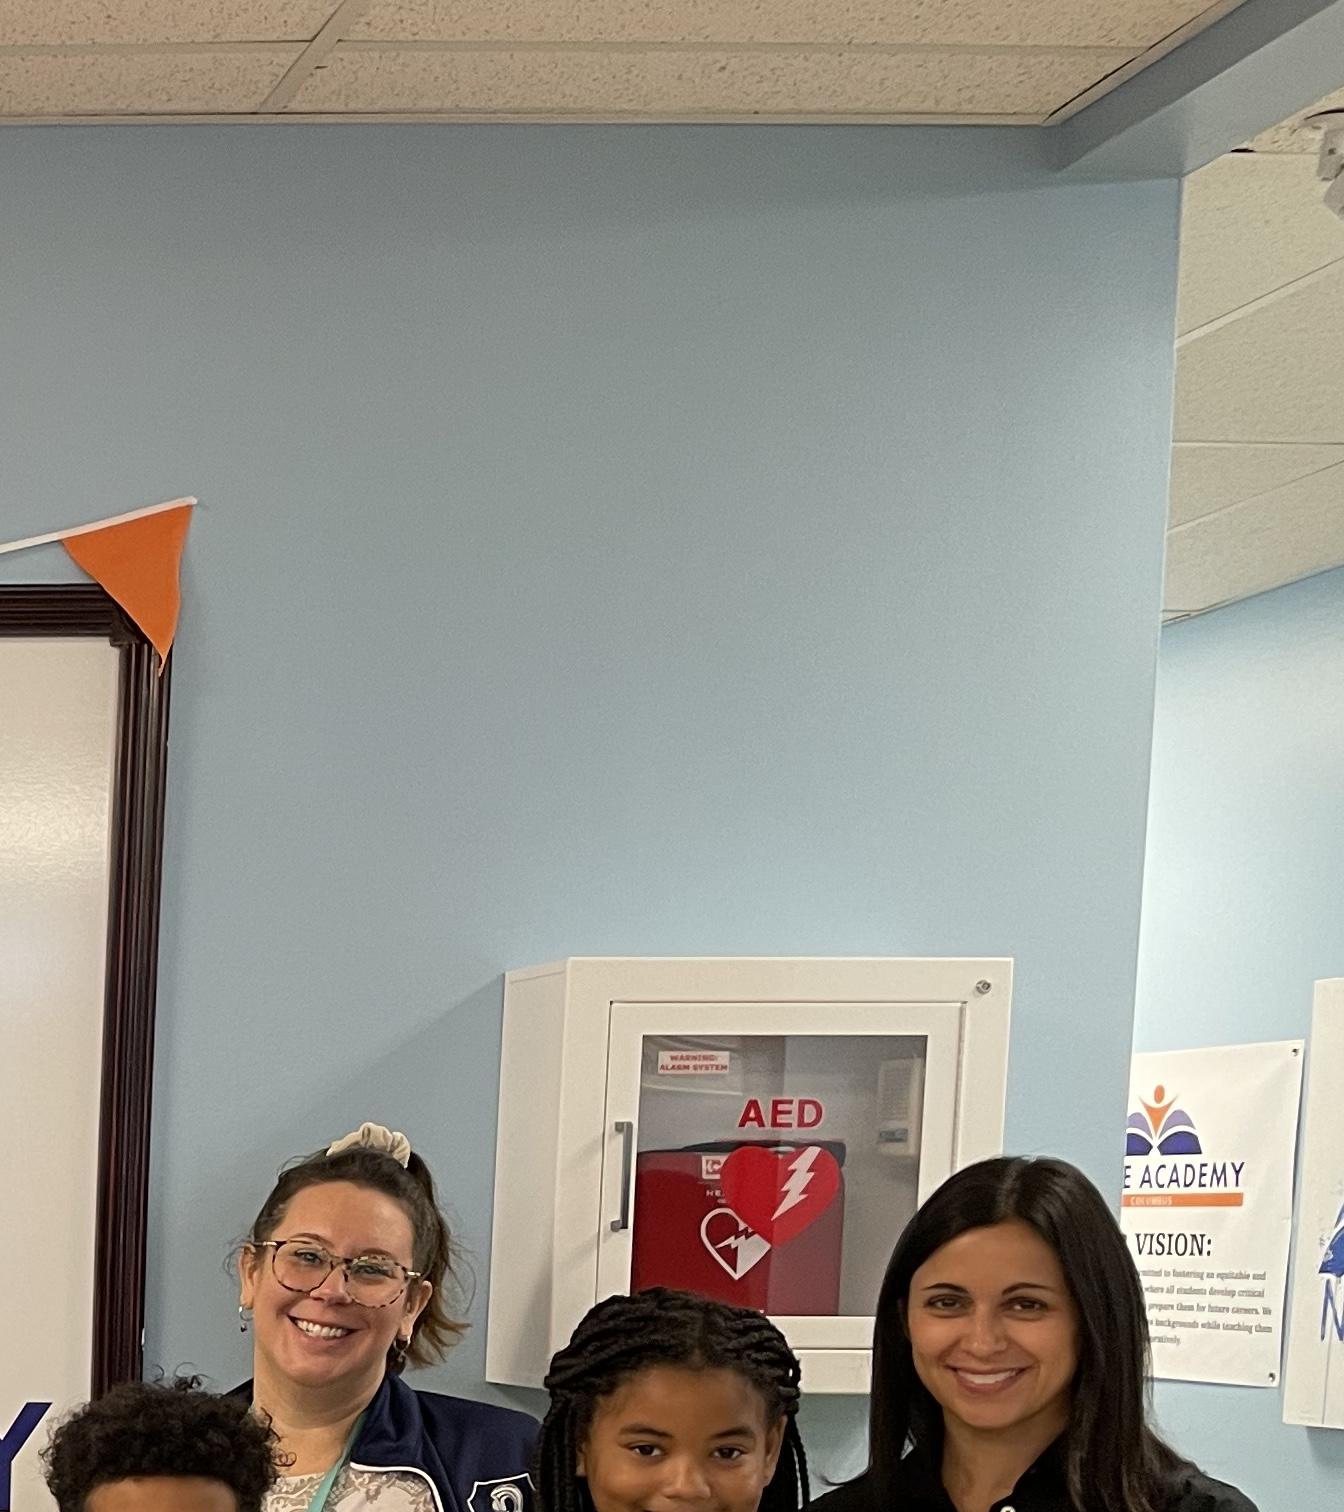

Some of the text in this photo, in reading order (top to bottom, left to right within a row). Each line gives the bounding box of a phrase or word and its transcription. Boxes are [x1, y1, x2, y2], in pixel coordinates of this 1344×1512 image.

[738, 1098, 823, 1129] AED
[1139, 1161, 1245, 1189] ACADEMY
[1135, 1232, 1212, 1257] VISION:
